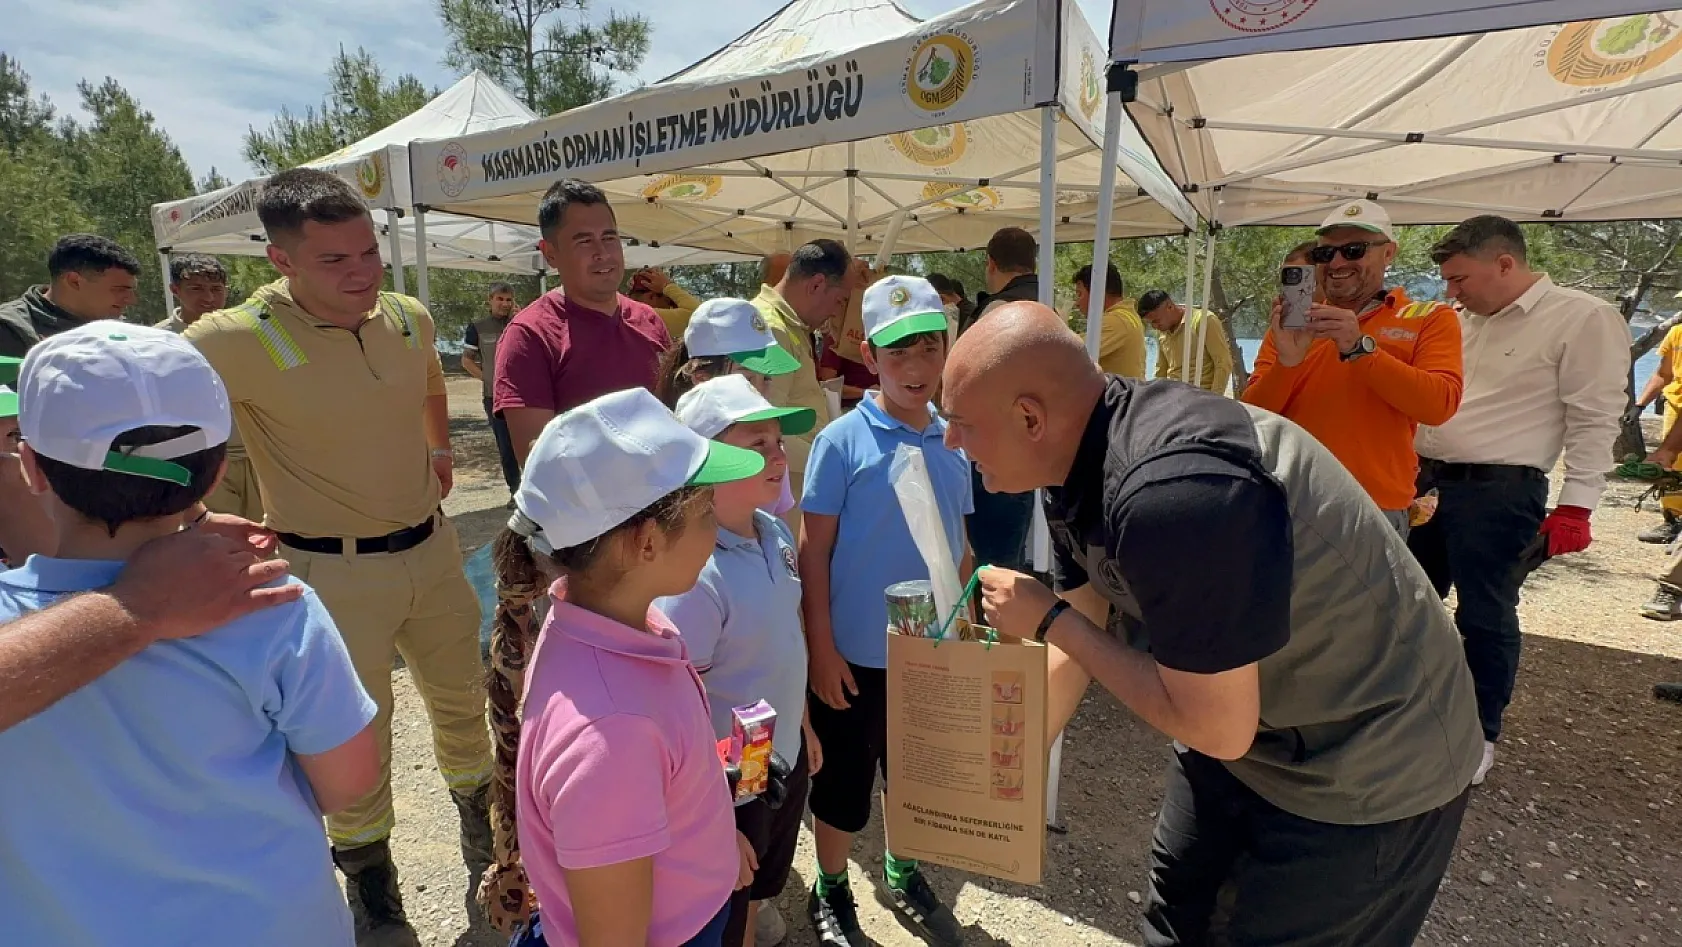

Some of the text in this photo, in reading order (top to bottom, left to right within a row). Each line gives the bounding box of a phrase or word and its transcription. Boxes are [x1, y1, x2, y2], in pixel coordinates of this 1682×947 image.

[920, 90, 941, 104] OGM
[481, 58, 864, 182] MARMARİS ORMAN İŞLETME MÜDÜRLÜĞÜ
[959, 827, 975, 837] SEN
[976, 829, 987, 839] DE
